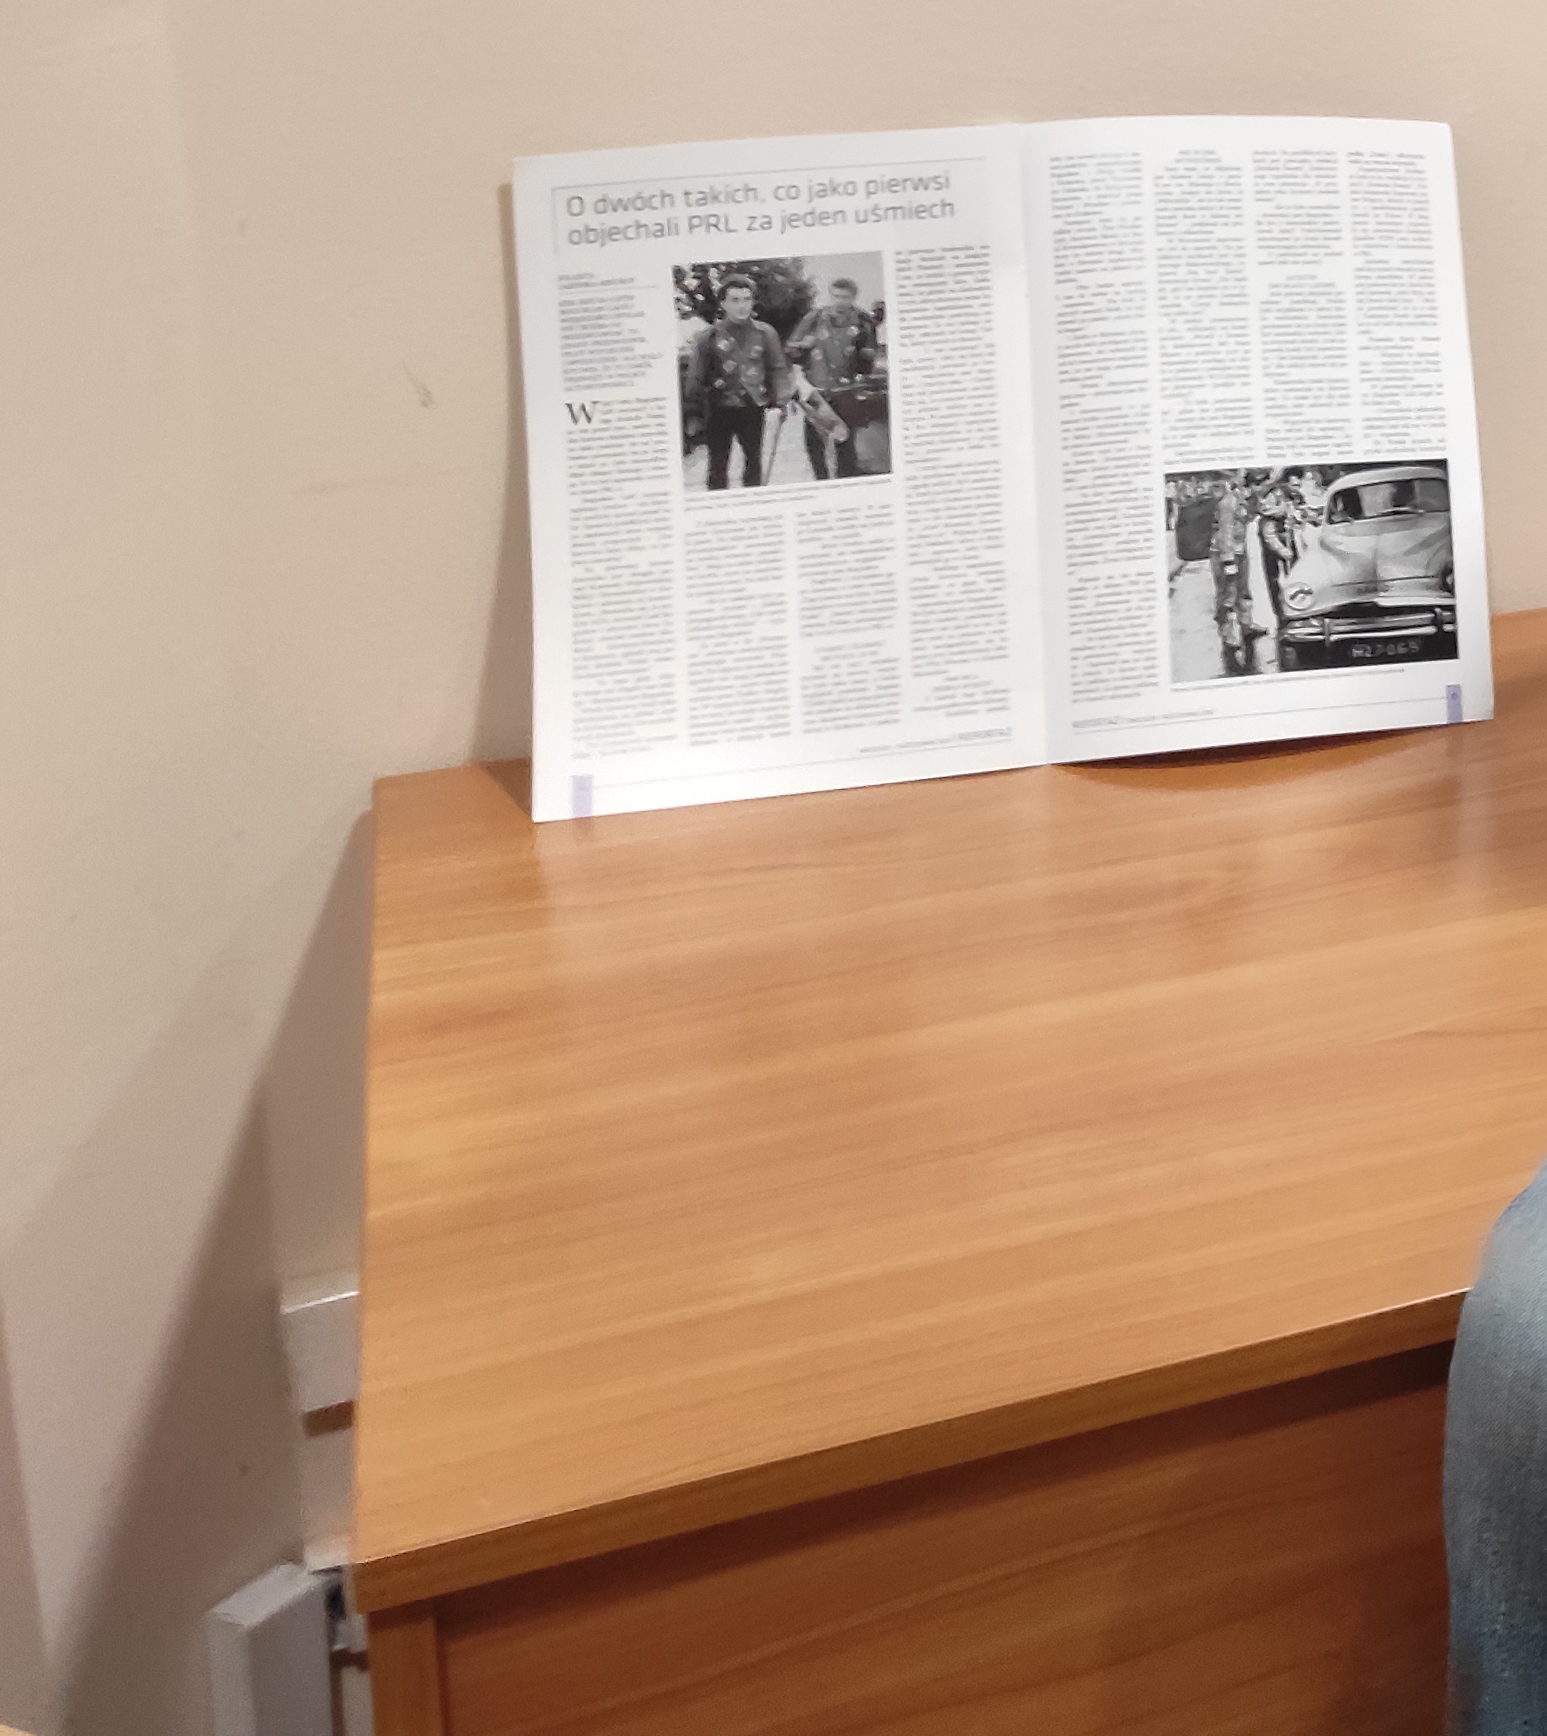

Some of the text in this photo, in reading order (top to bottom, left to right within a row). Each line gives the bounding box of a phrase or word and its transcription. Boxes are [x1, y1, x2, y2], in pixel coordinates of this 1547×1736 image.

[566, 195, 587, 217] O
[592, 189, 675, 215] dwóch
[773, 184, 800, 201] co
[806, 176, 858, 203] jako
[864, 170, 950, 199] pierwsi
[567, 197, 956, 248] objechali PRL za jeden uśmiech
